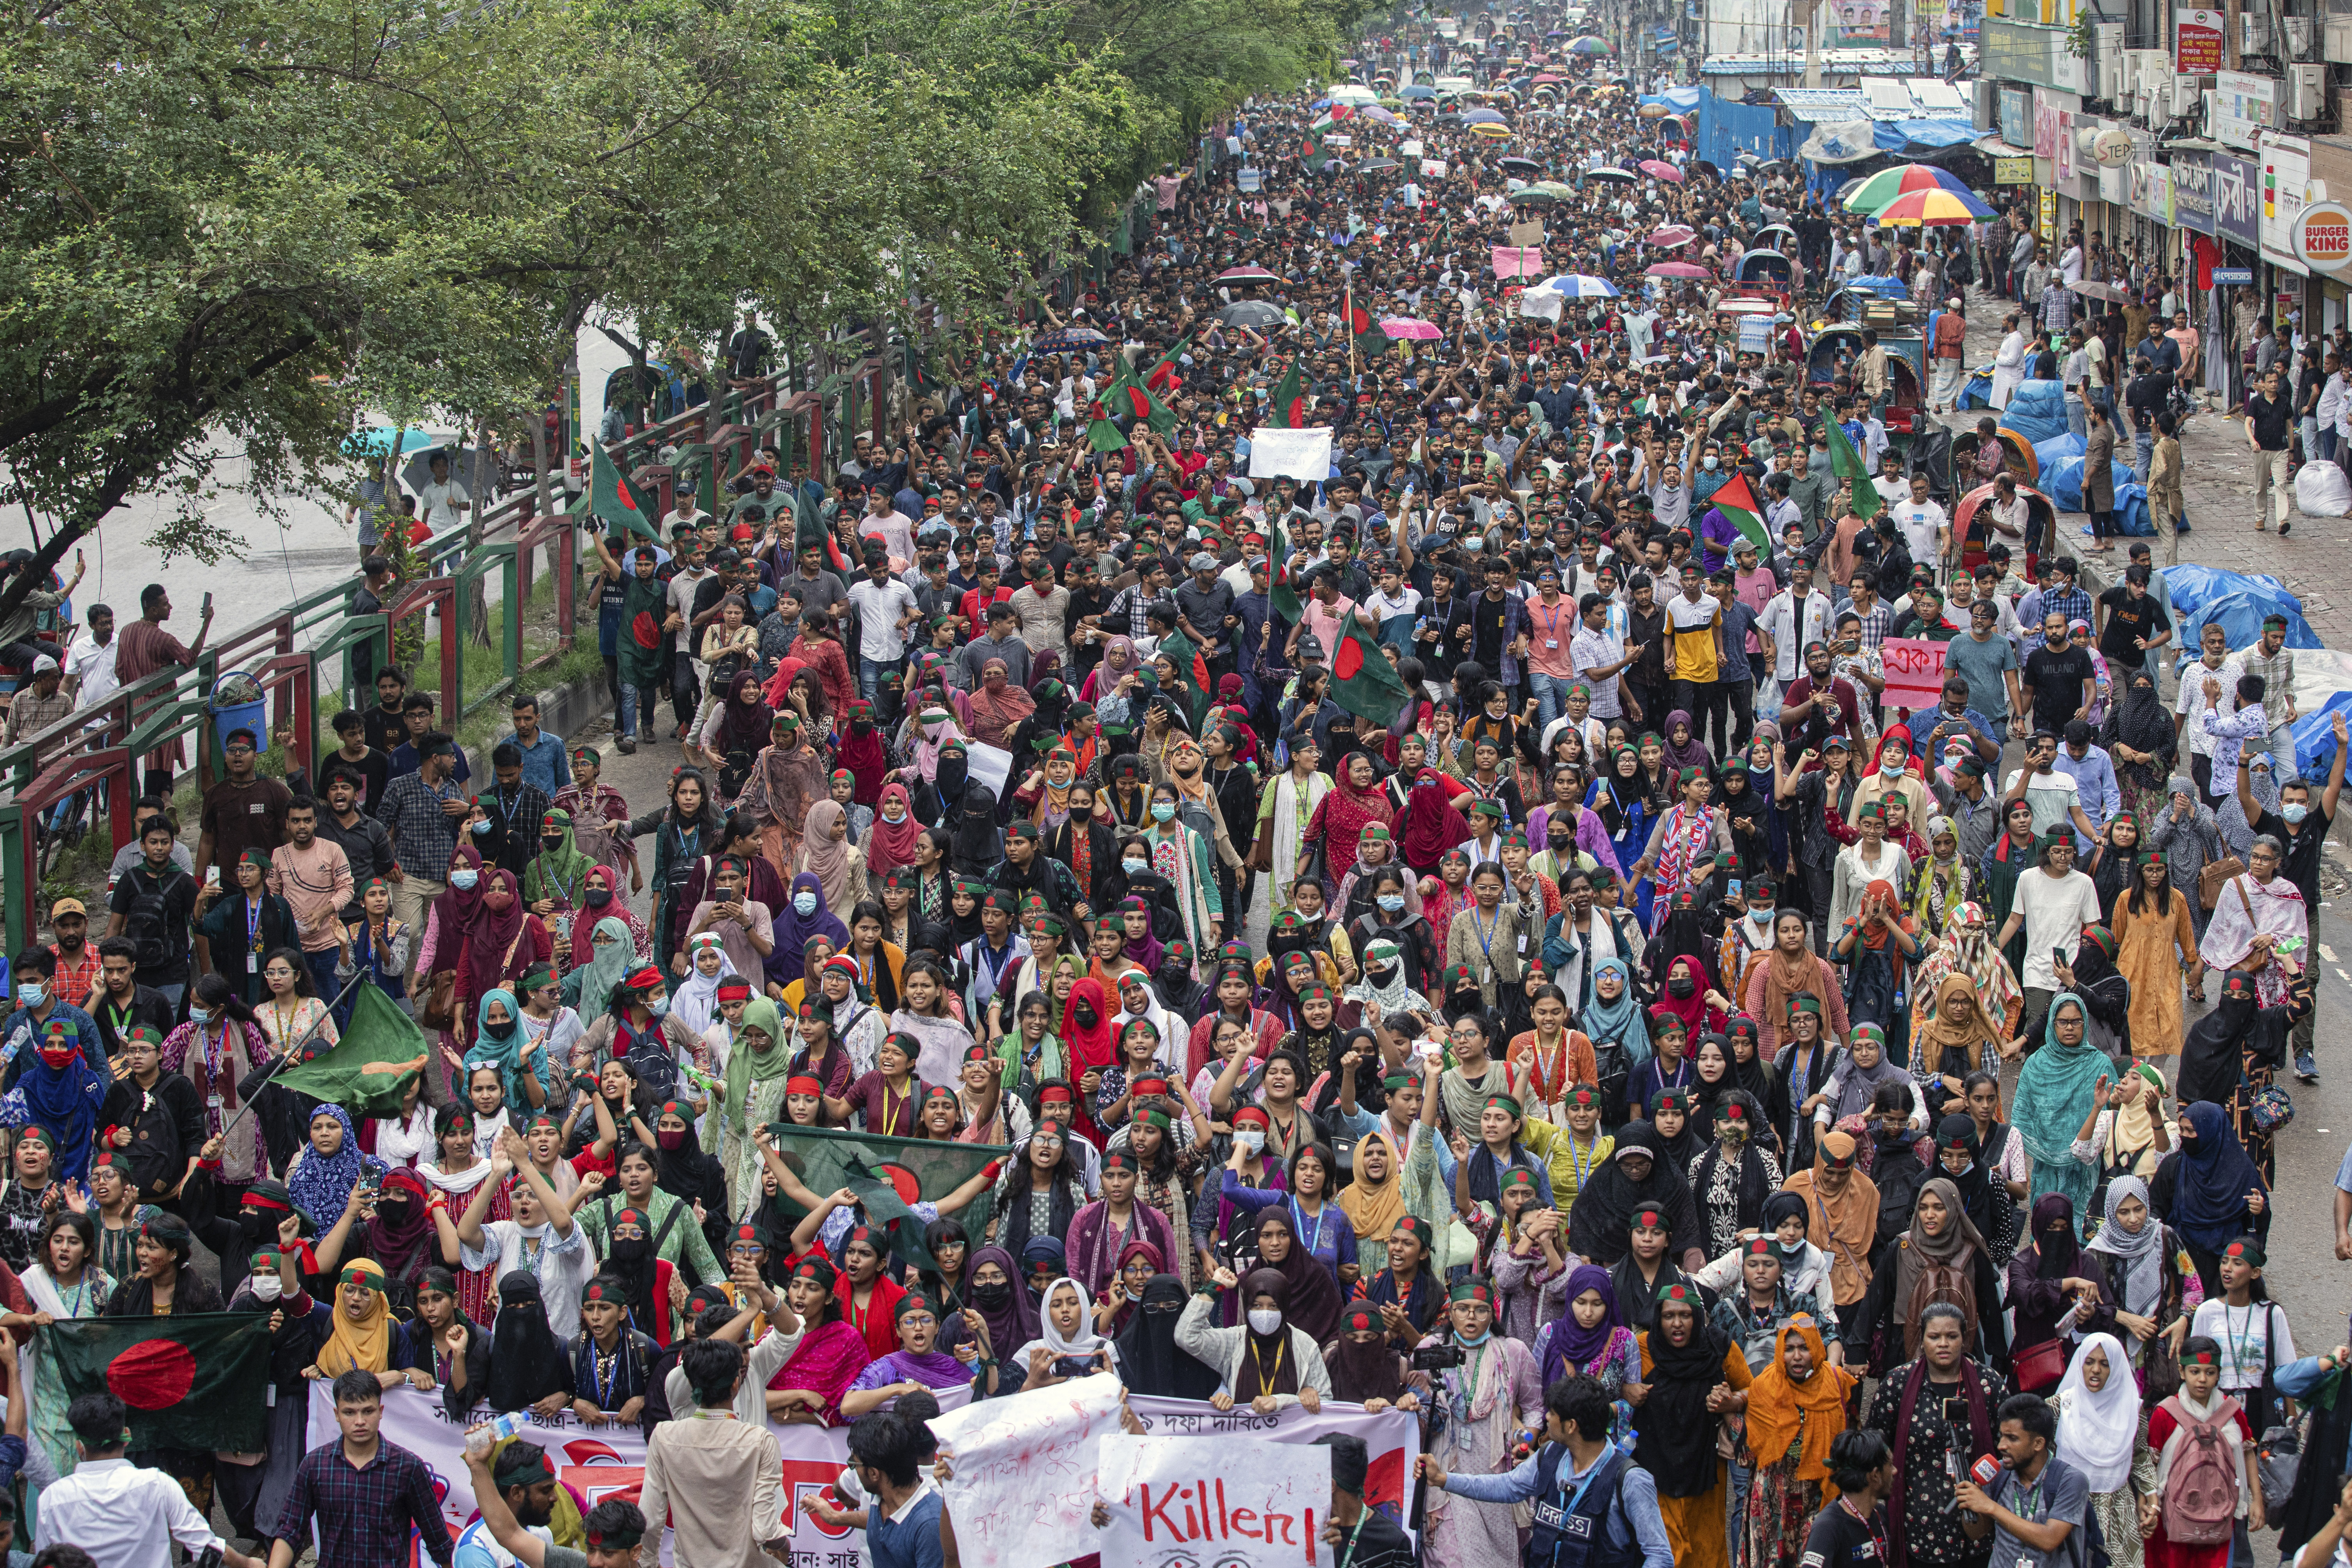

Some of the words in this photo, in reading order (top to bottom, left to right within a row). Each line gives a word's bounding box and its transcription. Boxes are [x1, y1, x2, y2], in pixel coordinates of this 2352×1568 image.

[2098, 138, 2130, 161] STEP
[2306, 227, 2348, 236] BURGER
[2306, 237, 2349, 251] KING
[2221, 272, 2252, 280] পেগাসাস
[1440, 522, 1456, 533] BOY
[1882, 647, 1928, 675] এক
[2043, 663, 2075, 675] MILANO
[1162, 1413, 1202, 1433] দফা
[1209, 1411, 1280, 1432] দাবিতে
[2030, 1489, 2039, 1509] PRESS
[1541, 1507, 1587, 1533] PRSS
[826, 1547, 859, 1567] সাই
